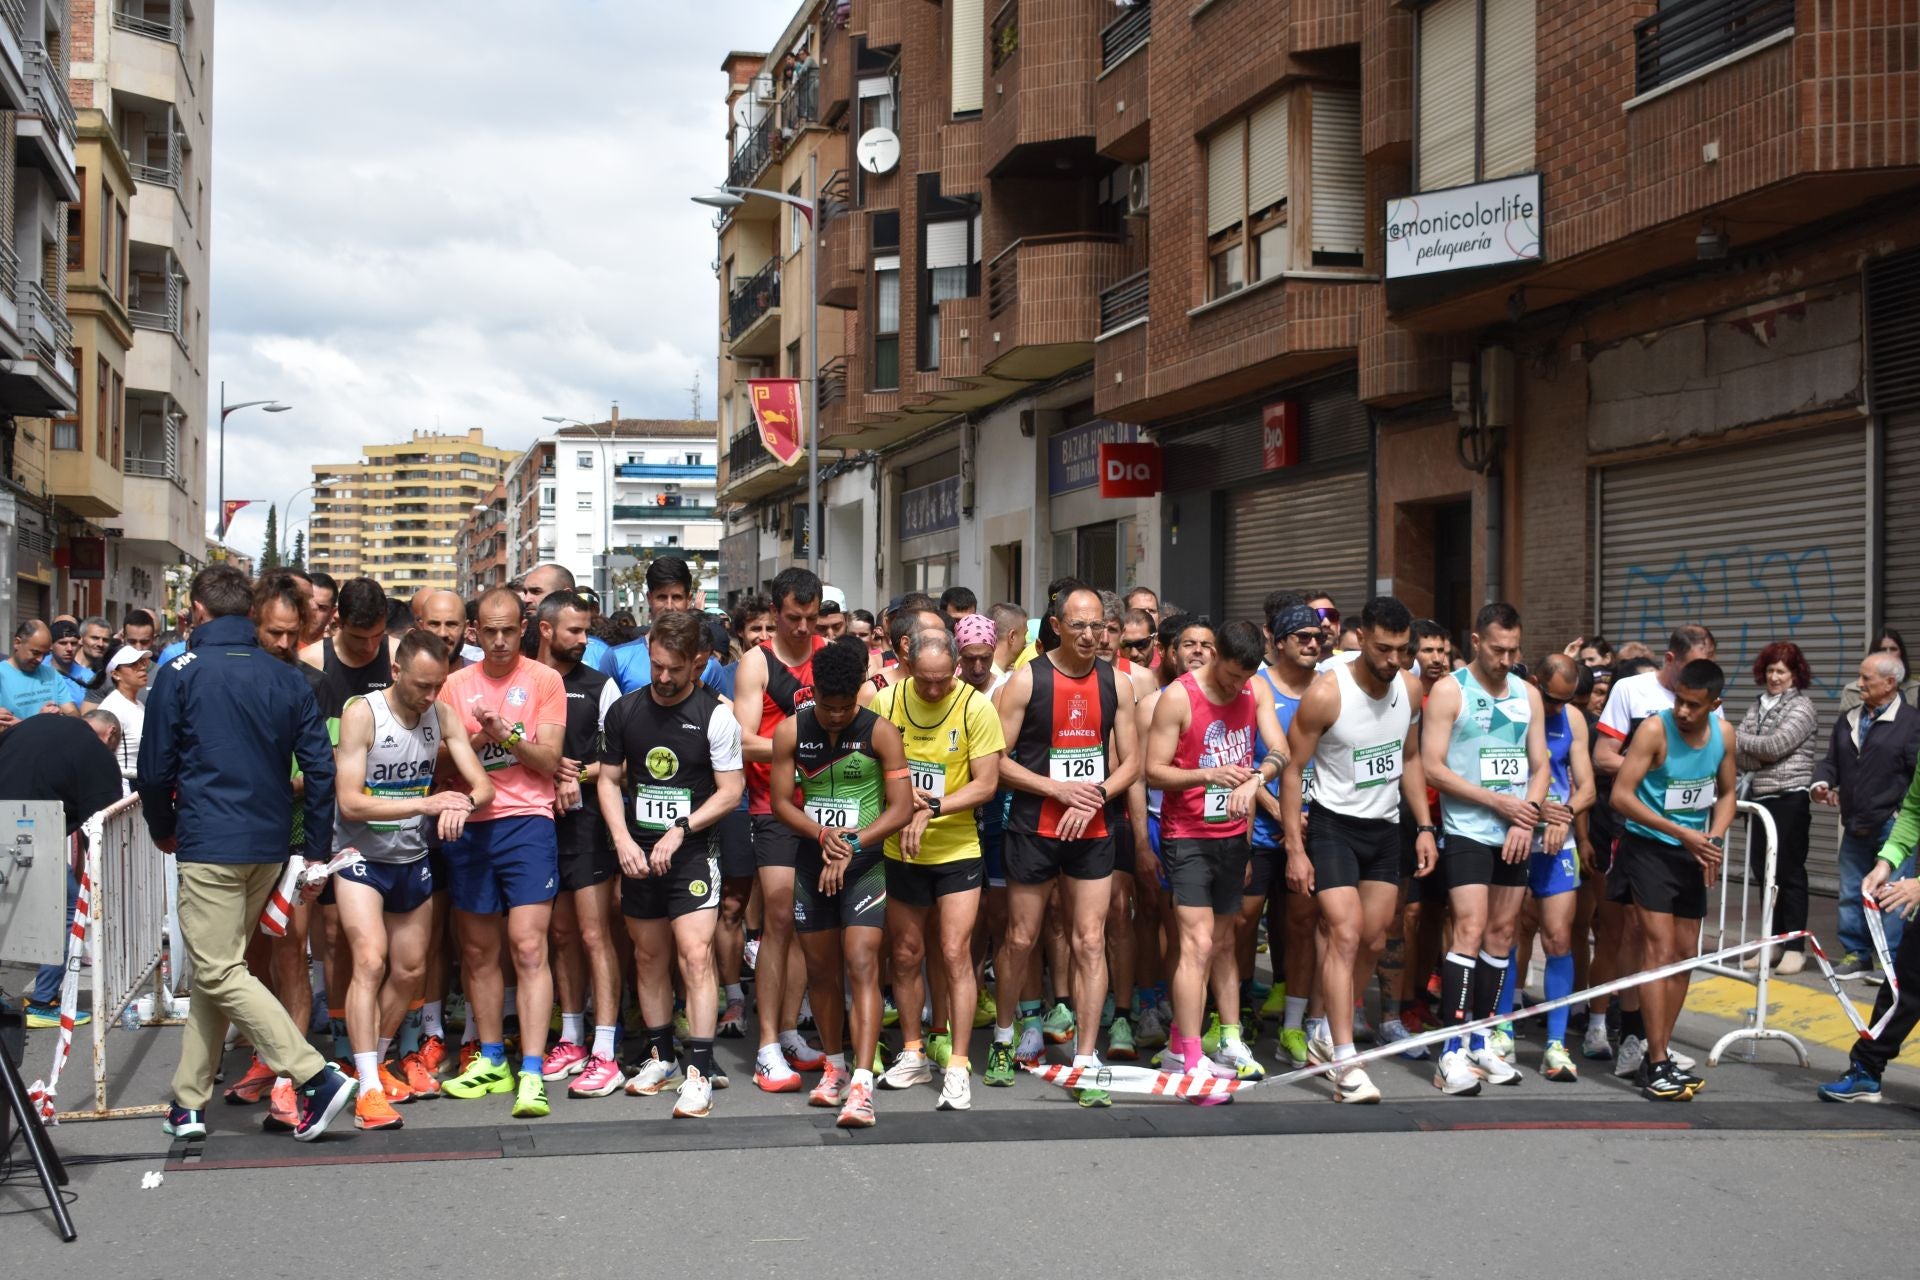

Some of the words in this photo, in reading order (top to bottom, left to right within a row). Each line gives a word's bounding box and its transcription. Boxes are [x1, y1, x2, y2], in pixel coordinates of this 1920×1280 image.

[1415, 231, 1492, 266] peluquería
[1062, 432, 1089, 464] BAZAR
[1058, 729, 1096, 737] SUANZES
[1062, 758, 1095, 778] 126
[1365, 754, 1394, 776] 185
[1491, 758, 1519, 775] 123
[1215, 794, 1229, 811] 2
[1681, 788, 1702, 805] 97
[646, 800, 678, 819] 115
[814, 808, 847, 827] 120
